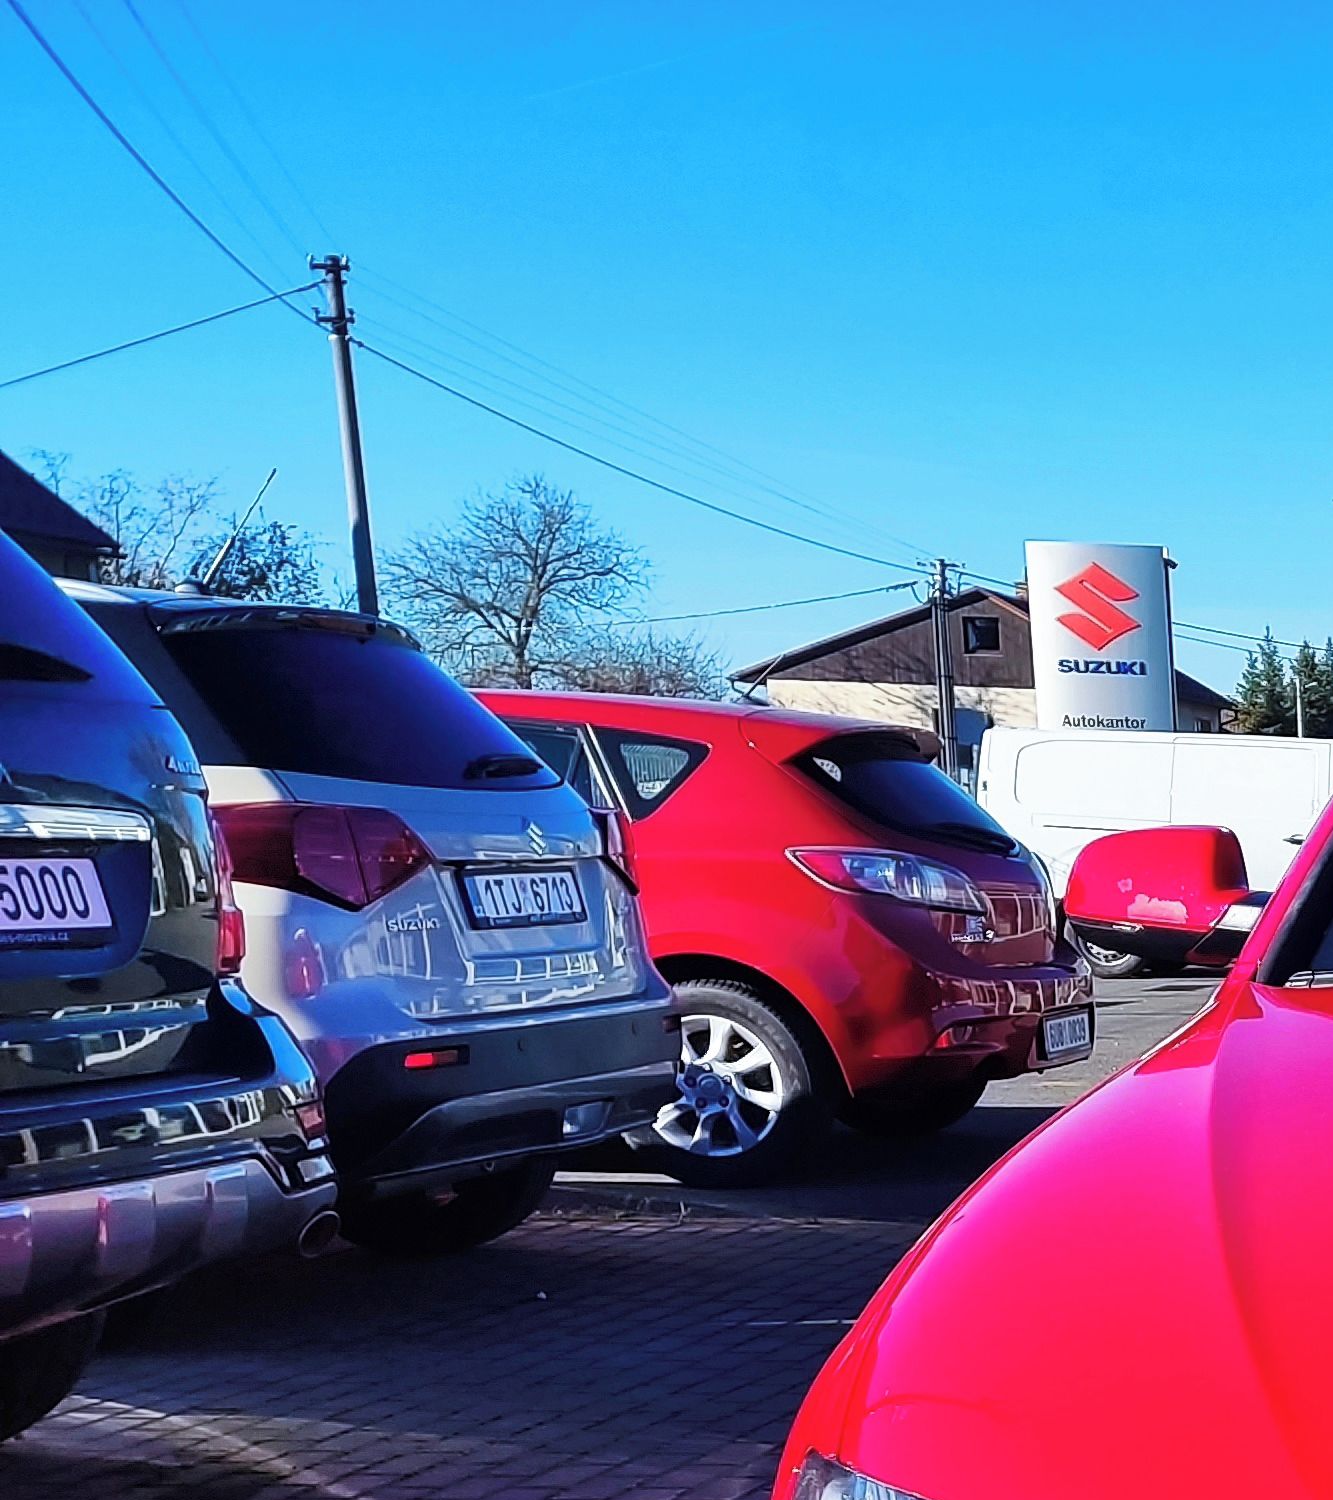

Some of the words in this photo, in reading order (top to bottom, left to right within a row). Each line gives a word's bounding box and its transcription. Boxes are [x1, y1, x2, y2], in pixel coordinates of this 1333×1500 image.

[1057, 658, 1148, 676] SUZUKI
[1061, 713, 1147, 729] Autokantor
[484, 878, 523, 916] 1TJ
[529, 876, 575, 912] 6713
[386, 917, 440, 932] SUZUKI
